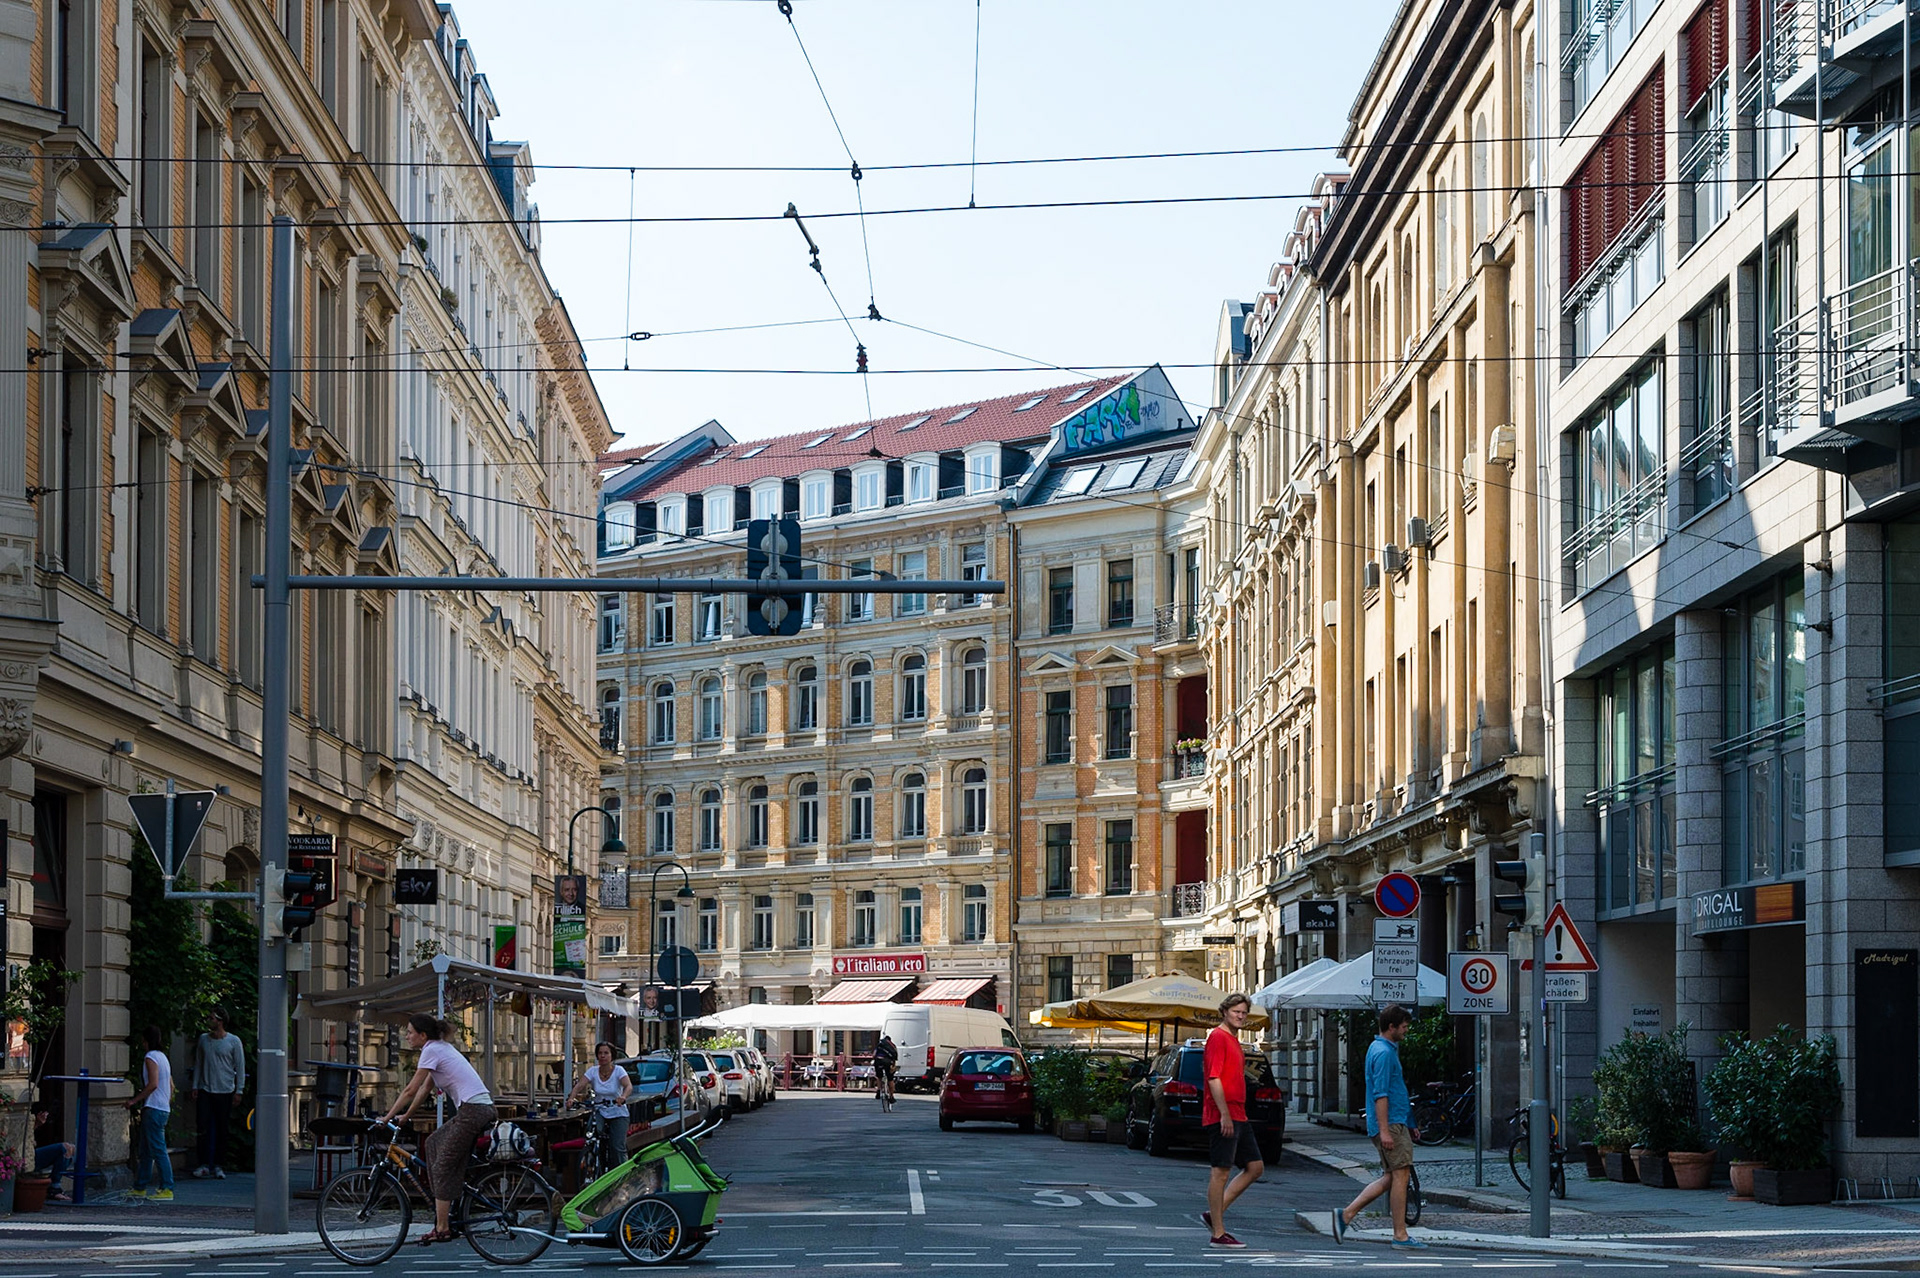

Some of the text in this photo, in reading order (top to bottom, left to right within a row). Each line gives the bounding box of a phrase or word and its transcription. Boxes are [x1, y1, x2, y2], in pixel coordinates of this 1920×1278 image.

[288, 836, 331, 845] VODKARIA
[400, 877, 432, 897] sky
[1305, 919, 1336, 929] skala
[1378, 948, 1414, 956] Kranken-
[1376, 957, 1415, 967] fahrzeuge
[1863, 953, 1909, 966] Madrigal
[1388, 965, 1402, 973] frei
[1468, 968, 1490, 985] 30
[1381, 982, 1407, 990] Mo-Fr
[1545, 977, 1580, 986] traßen-
[1546, 988, 1579, 997] chäden
[1463, 998, 1494, 1008] ZONE
